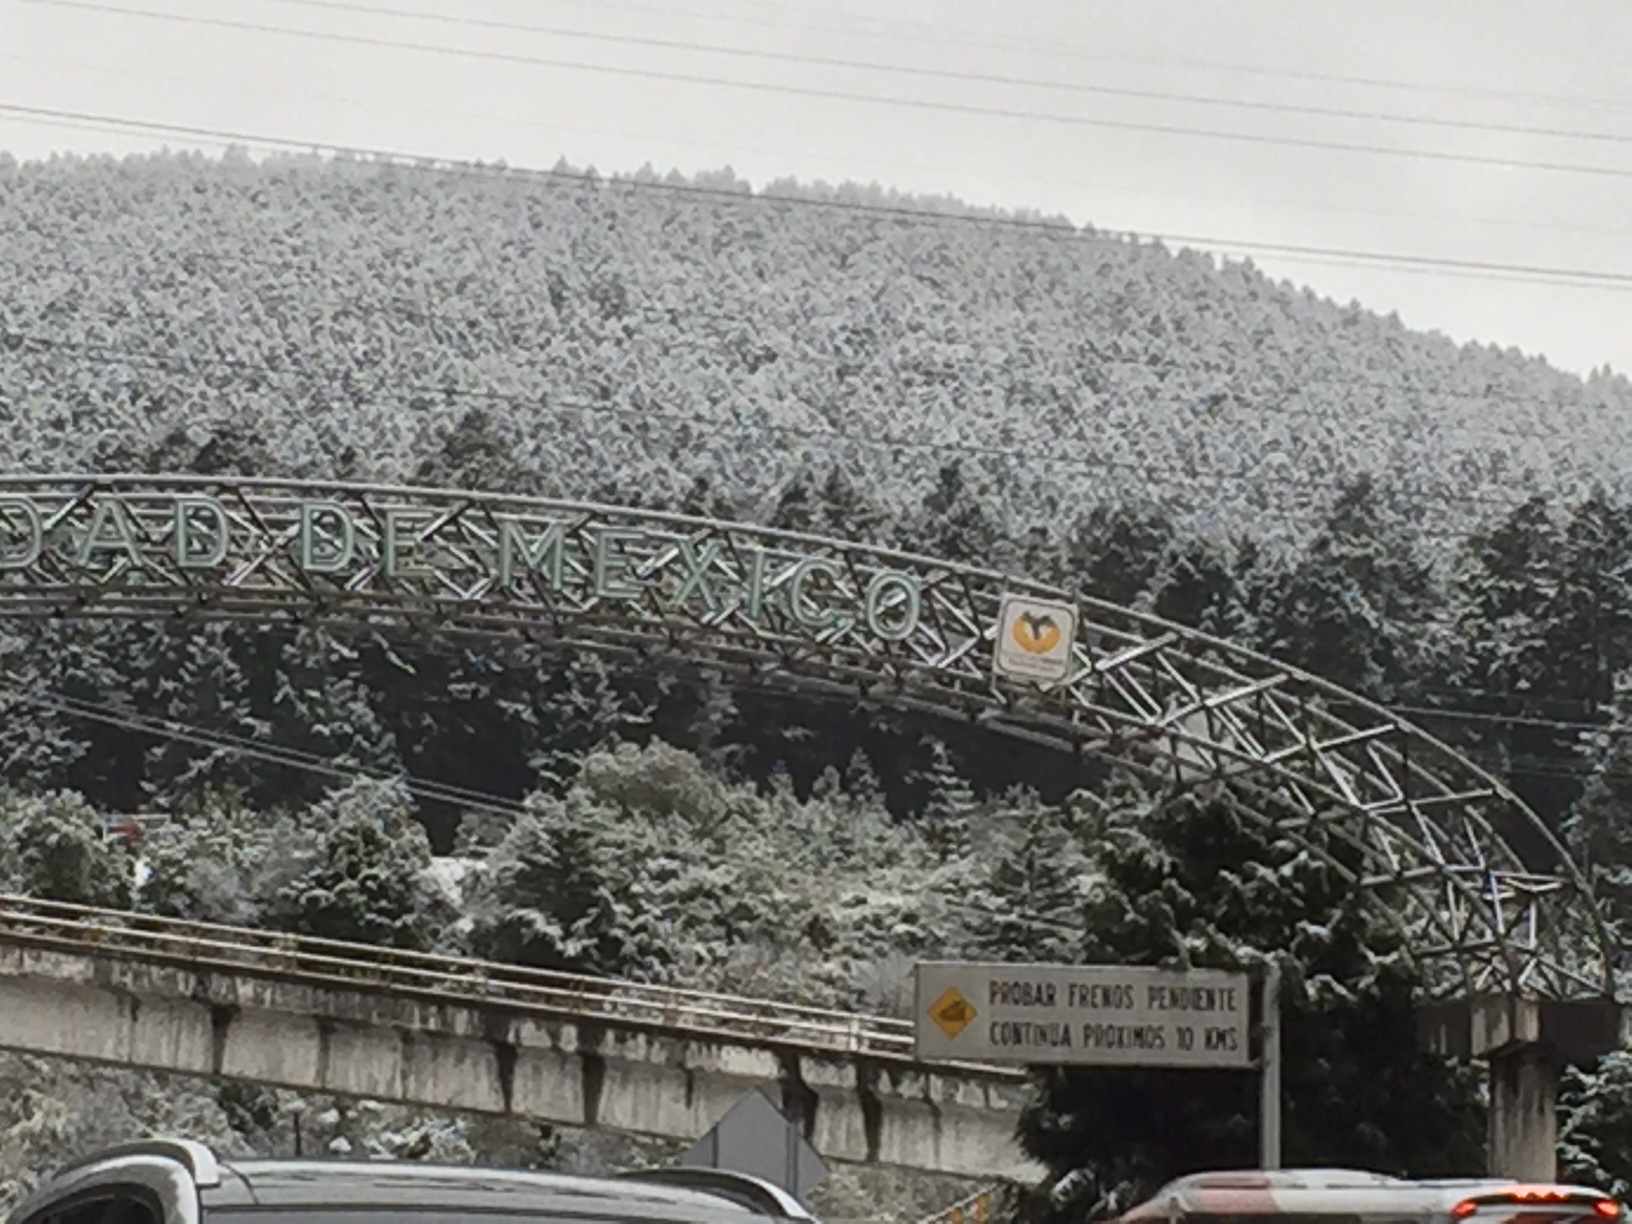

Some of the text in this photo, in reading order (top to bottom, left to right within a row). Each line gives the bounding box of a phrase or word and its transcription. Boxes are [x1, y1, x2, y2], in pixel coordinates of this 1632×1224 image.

[300, 501, 435, 578] DE
[498, 519, 921, 641] MEXICO
[989, 980, 1237, 1011] PROBAR FRENOS PENDIENTE
[989, 1021, 1239, 1052] CONTINUA PROXIMOS 10 KMS
